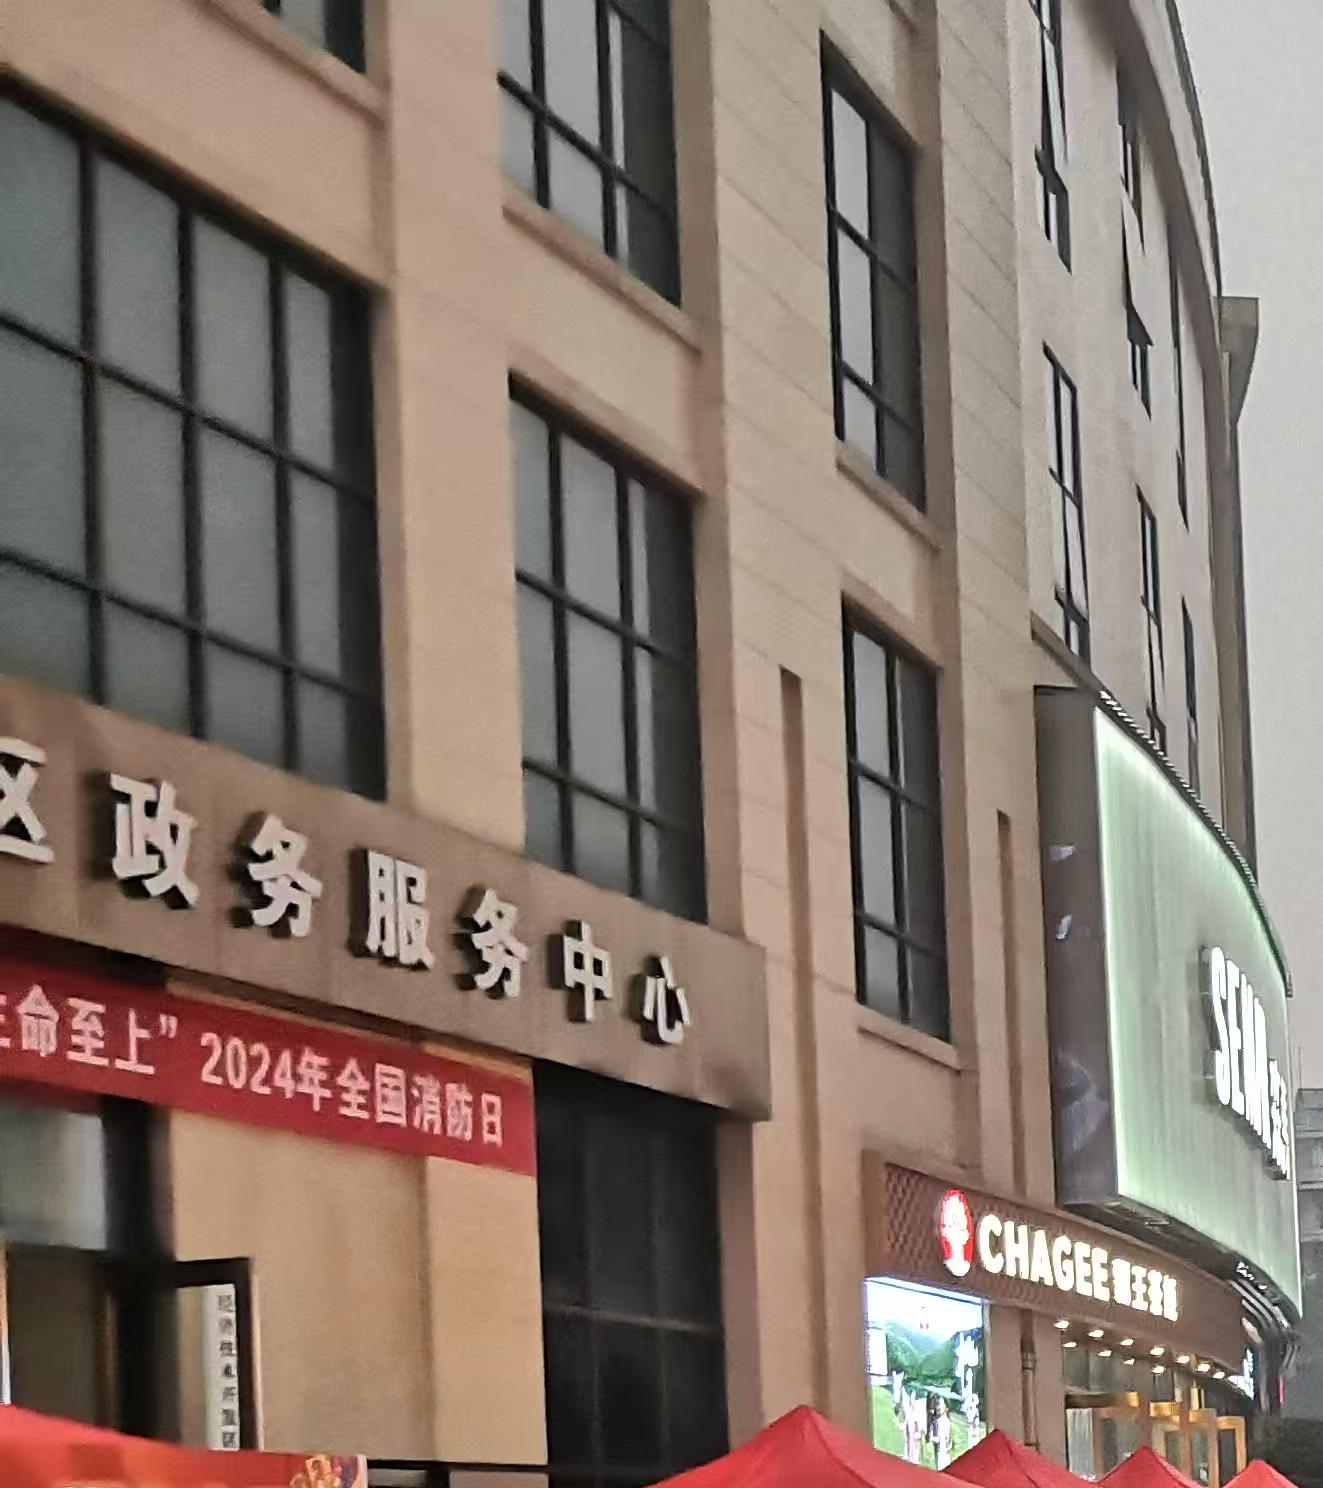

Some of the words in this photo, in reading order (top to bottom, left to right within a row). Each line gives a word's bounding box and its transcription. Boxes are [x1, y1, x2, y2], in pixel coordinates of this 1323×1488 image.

[0, 737, 690, 1046] 区政务服务中心
[0, 985, 178, 1075] 命至上”
[201, 1032, 502, 1147] 2024年全国消防日
[977, 1214, 1110, 1302] CHAGEE
